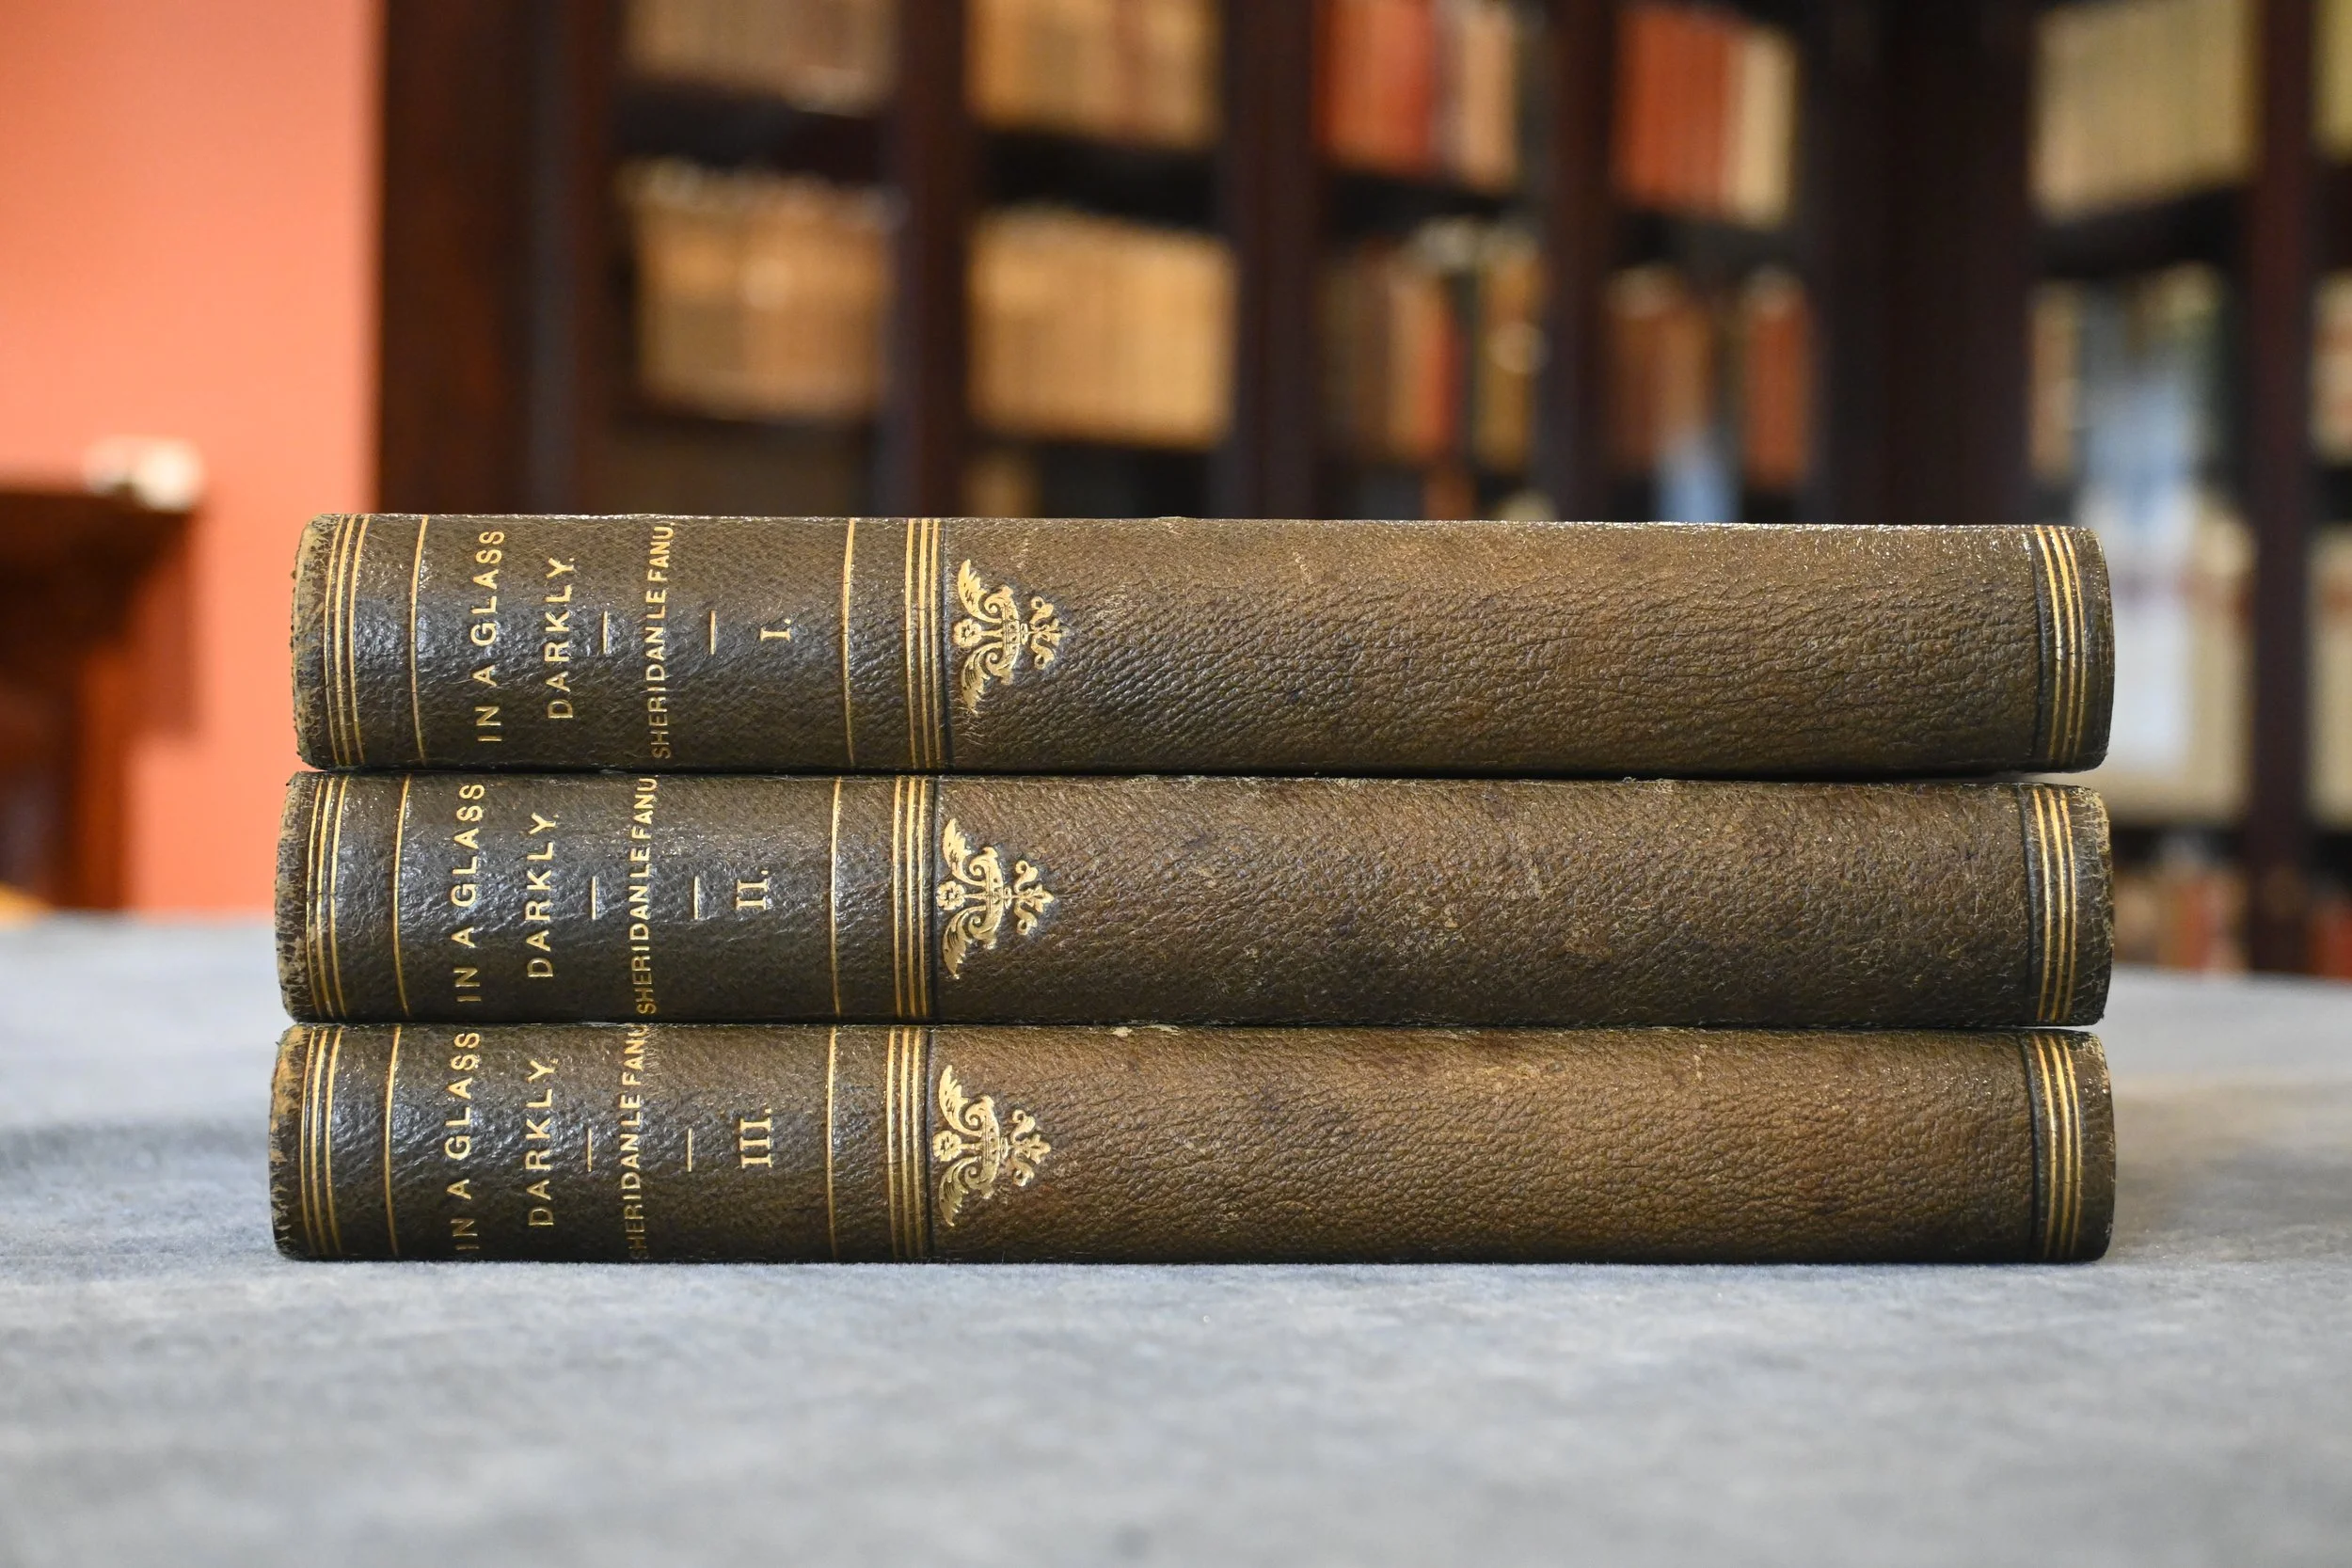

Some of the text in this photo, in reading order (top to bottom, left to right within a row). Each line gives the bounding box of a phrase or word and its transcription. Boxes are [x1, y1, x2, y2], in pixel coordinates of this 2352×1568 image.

[470, 531, 505, 742] IN A GLASS
[544, 557, 575, 720] DARKLY.
[645, 589, 667, 619] LE
[759, 618, 792, 642] I.
[645, 626, 671, 759] SHERIDAN
[451, 784, 485, 1003] IN A GLASS
[524, 812, 560, 978] DARKLY.
[628, 847, 650, 879] LE
[735, 869, 769, 911] II.
[628, 884, 657, 1014] SHERIDAN
[444, 1032, 481, 1251] IN A GLASS
[620, 1094, 643, 1127] LE
[739, 1108, 773, 1168] III.
[620, 1133, 649, 1259] SHERIDAN
